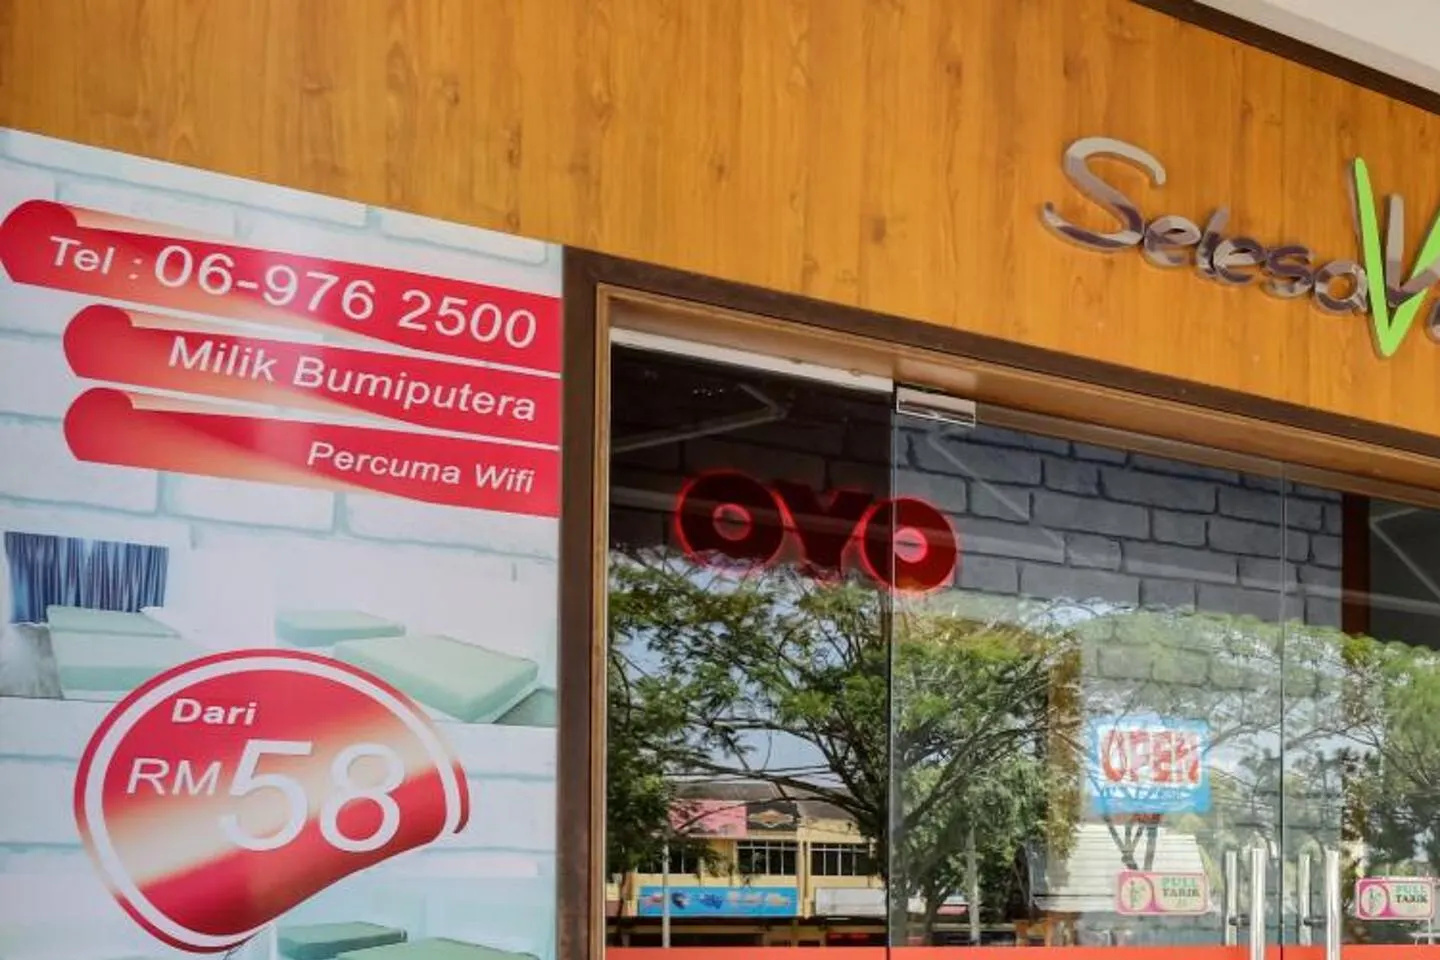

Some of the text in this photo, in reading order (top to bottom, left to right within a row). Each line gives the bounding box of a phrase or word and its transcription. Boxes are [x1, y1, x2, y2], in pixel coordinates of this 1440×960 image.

[49, 235, 114, 275] Tel
[153, 245, 376, 321] 06-976
[397, 289, 537, 350] 2500
[168, 335, 536, 422] Milik Bumiputera
[306, 440, 536, 495] Percuma Wifi
[676, 469, 958, 594] OYO
[171, 698, 257, 726] Dari
[1102, 728, 1200, 784] OPEN
